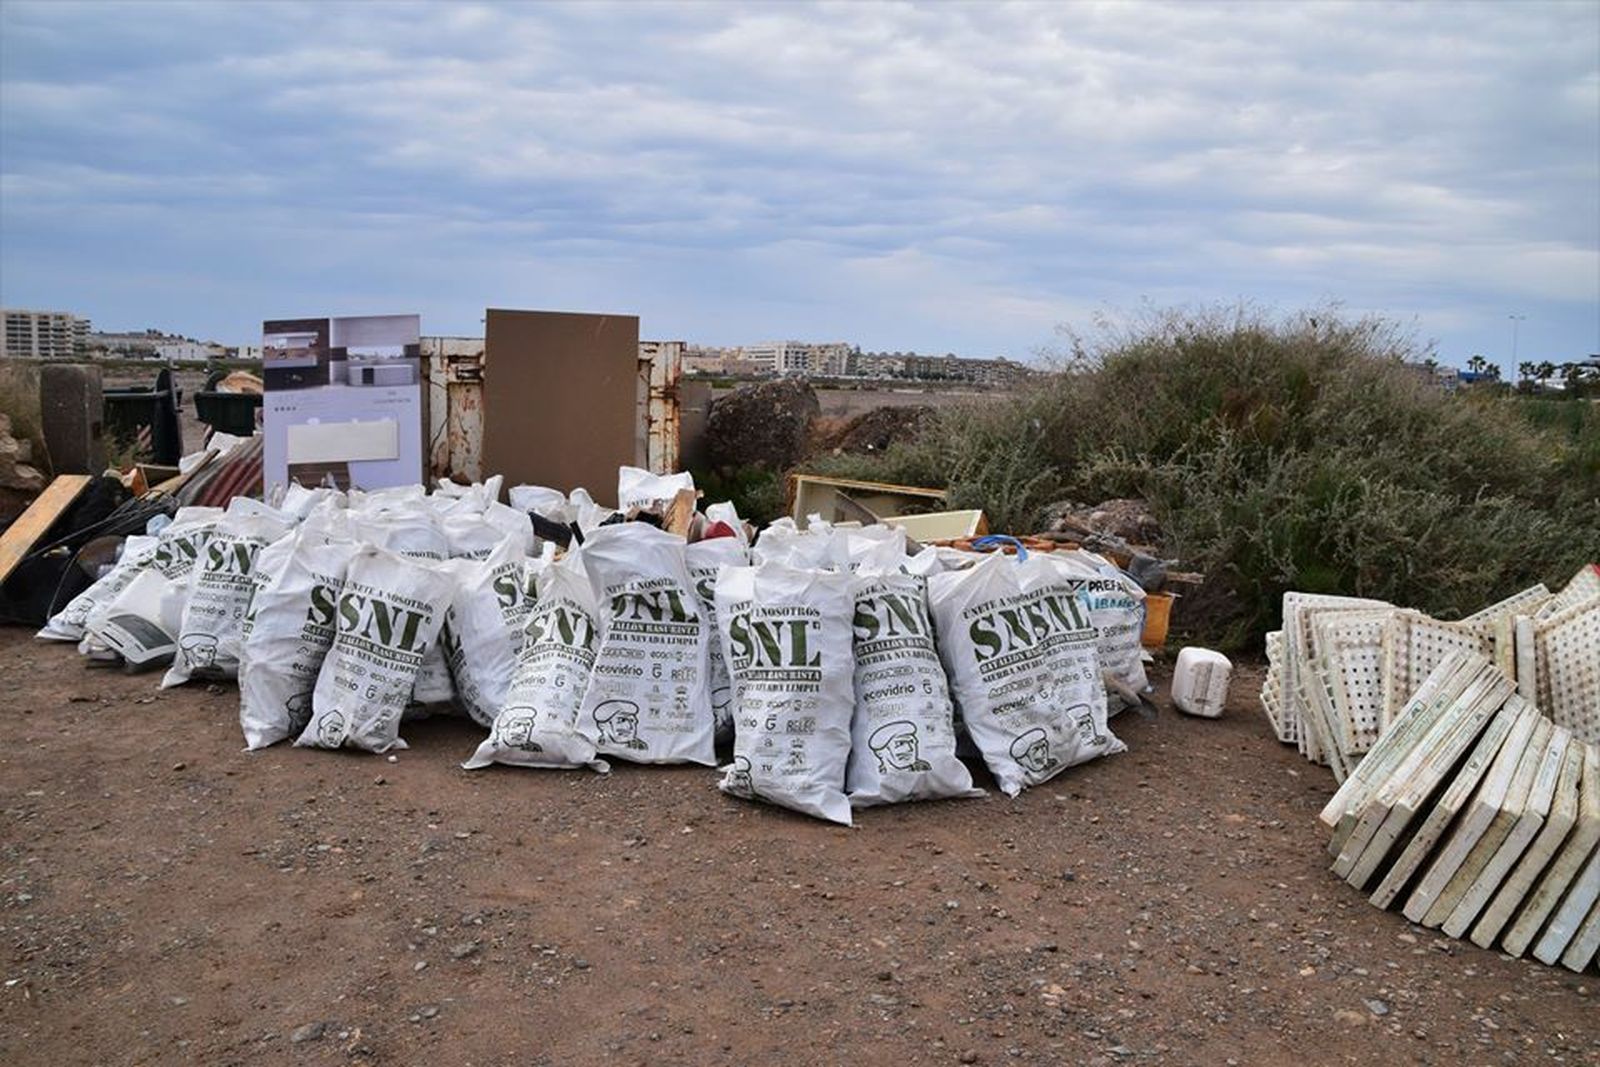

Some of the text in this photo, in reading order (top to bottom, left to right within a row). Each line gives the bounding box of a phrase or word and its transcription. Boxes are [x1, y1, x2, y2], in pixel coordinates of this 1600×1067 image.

[204, 540, 263, 575] SN
[339, 593, 427, 654] SNL
[760, 606, 821, 617] NOSOTROS
[730, 612, 821, 668] SNL
[969, 608, 1034, 663] SN
[863, 684, 916, 702] ecovidrio
